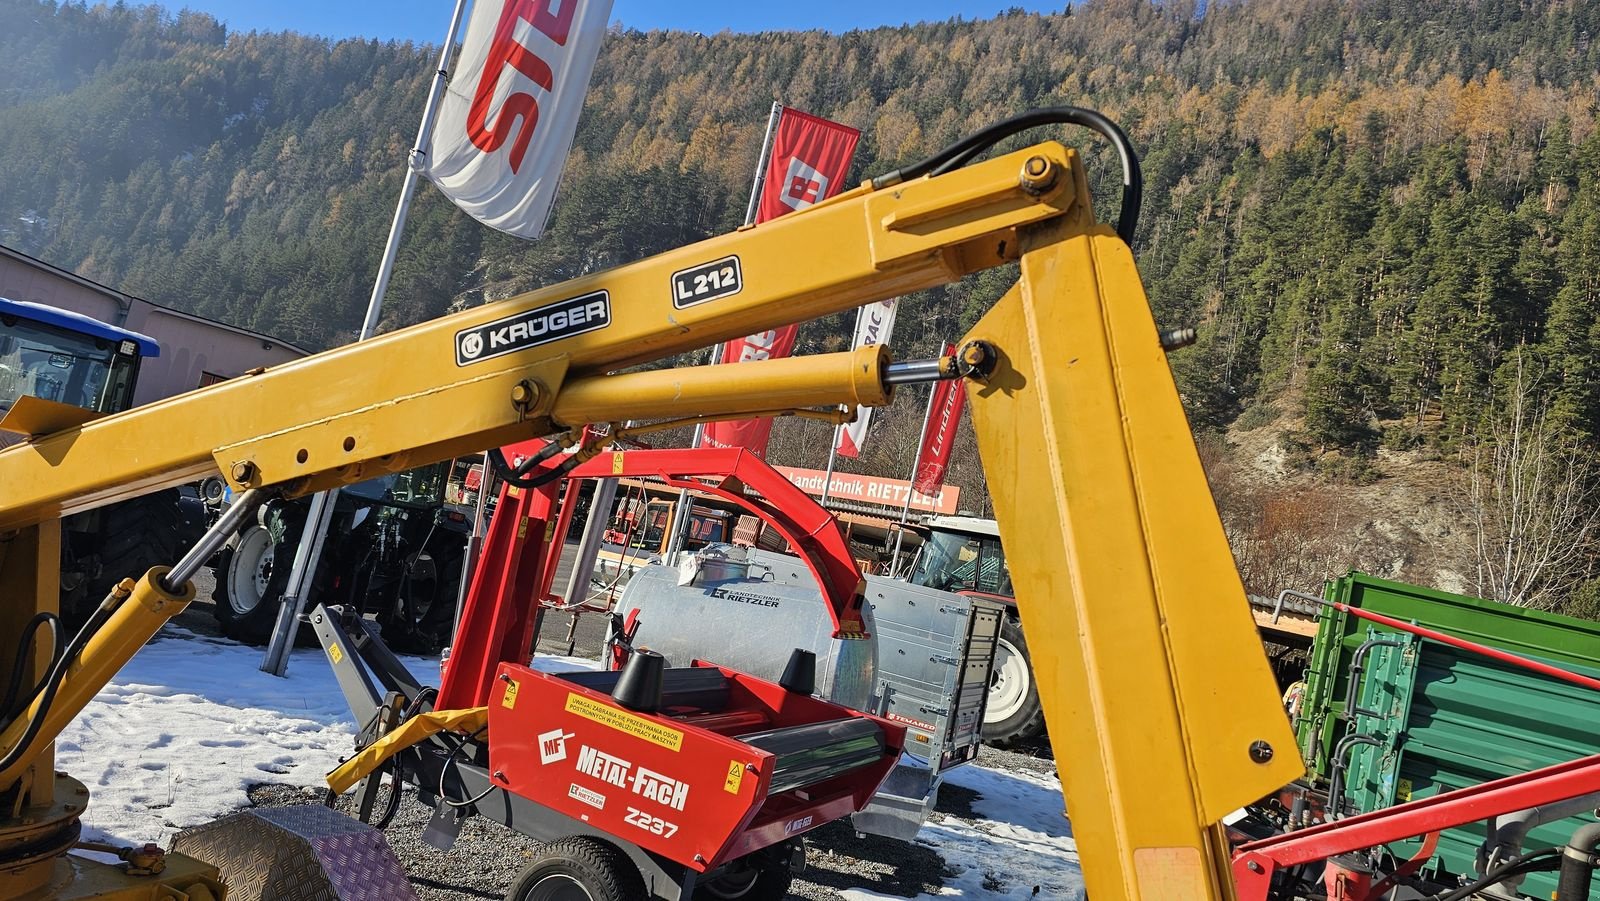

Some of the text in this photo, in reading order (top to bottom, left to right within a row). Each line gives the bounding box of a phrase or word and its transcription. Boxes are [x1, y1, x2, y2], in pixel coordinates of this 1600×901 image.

[677, 266, 736, 300] L212
[489, 300, 607, 349] KRÜGER
[931, 380, 958, 456] Lindner
[727, 595, 779, 608] RIETZLER
[730, 591, 781, 602] LANDTECHNIK
[569, 703, 606, 723] POSTRONNYCH
[634, 726, 652, 738] PRACY
[651, 733, 677, 747] MASZYNY
[592, 704, 618, 719] ZABRANIA
[626, 717, 662, 735] PRZEBYWANIA
[896, 715, 936, 730] TEMARED
[624, 806, 678, 839] Z237
